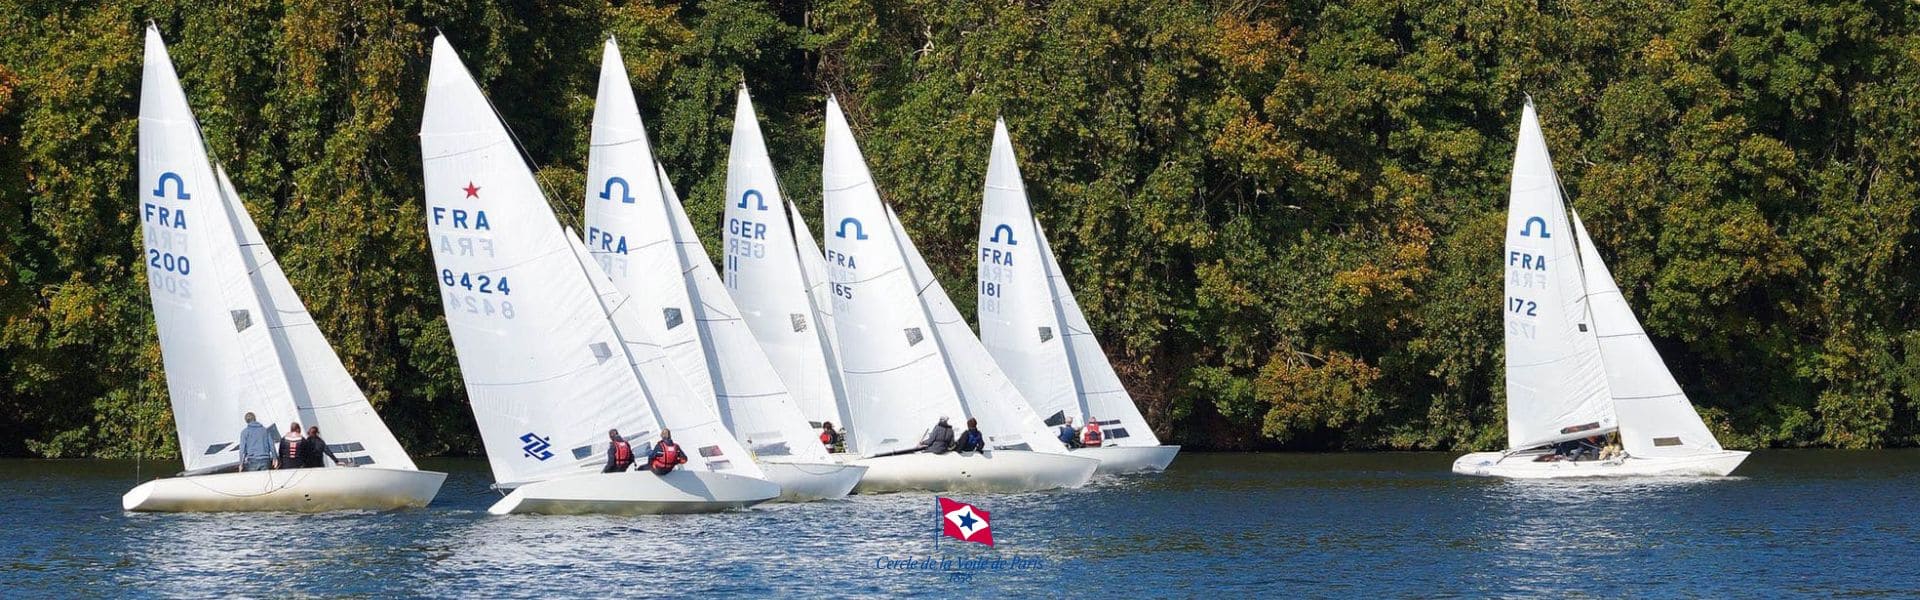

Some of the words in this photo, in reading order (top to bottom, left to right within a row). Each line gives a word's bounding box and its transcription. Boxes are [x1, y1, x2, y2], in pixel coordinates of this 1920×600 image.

[145, 203, 187, 229] FRA
[433, 206, 490, 230] FRA
[730, 218, 767, 240] GER
[589, 226, 628, 255] FRA
[149, 248, 190, 275] 200
[728, 254, 738, 272] 11
[828, 249, 856, 269] FRA
[982, 248, 1013, 266] FRA
[1510, 251, 1546, 271] FRA
[442, 269, 510, 295] 8424
[831, 282, 852, 300] 165
[982, 281, 1000, 298] 181
[1509, 296, 1537, 317] 172
